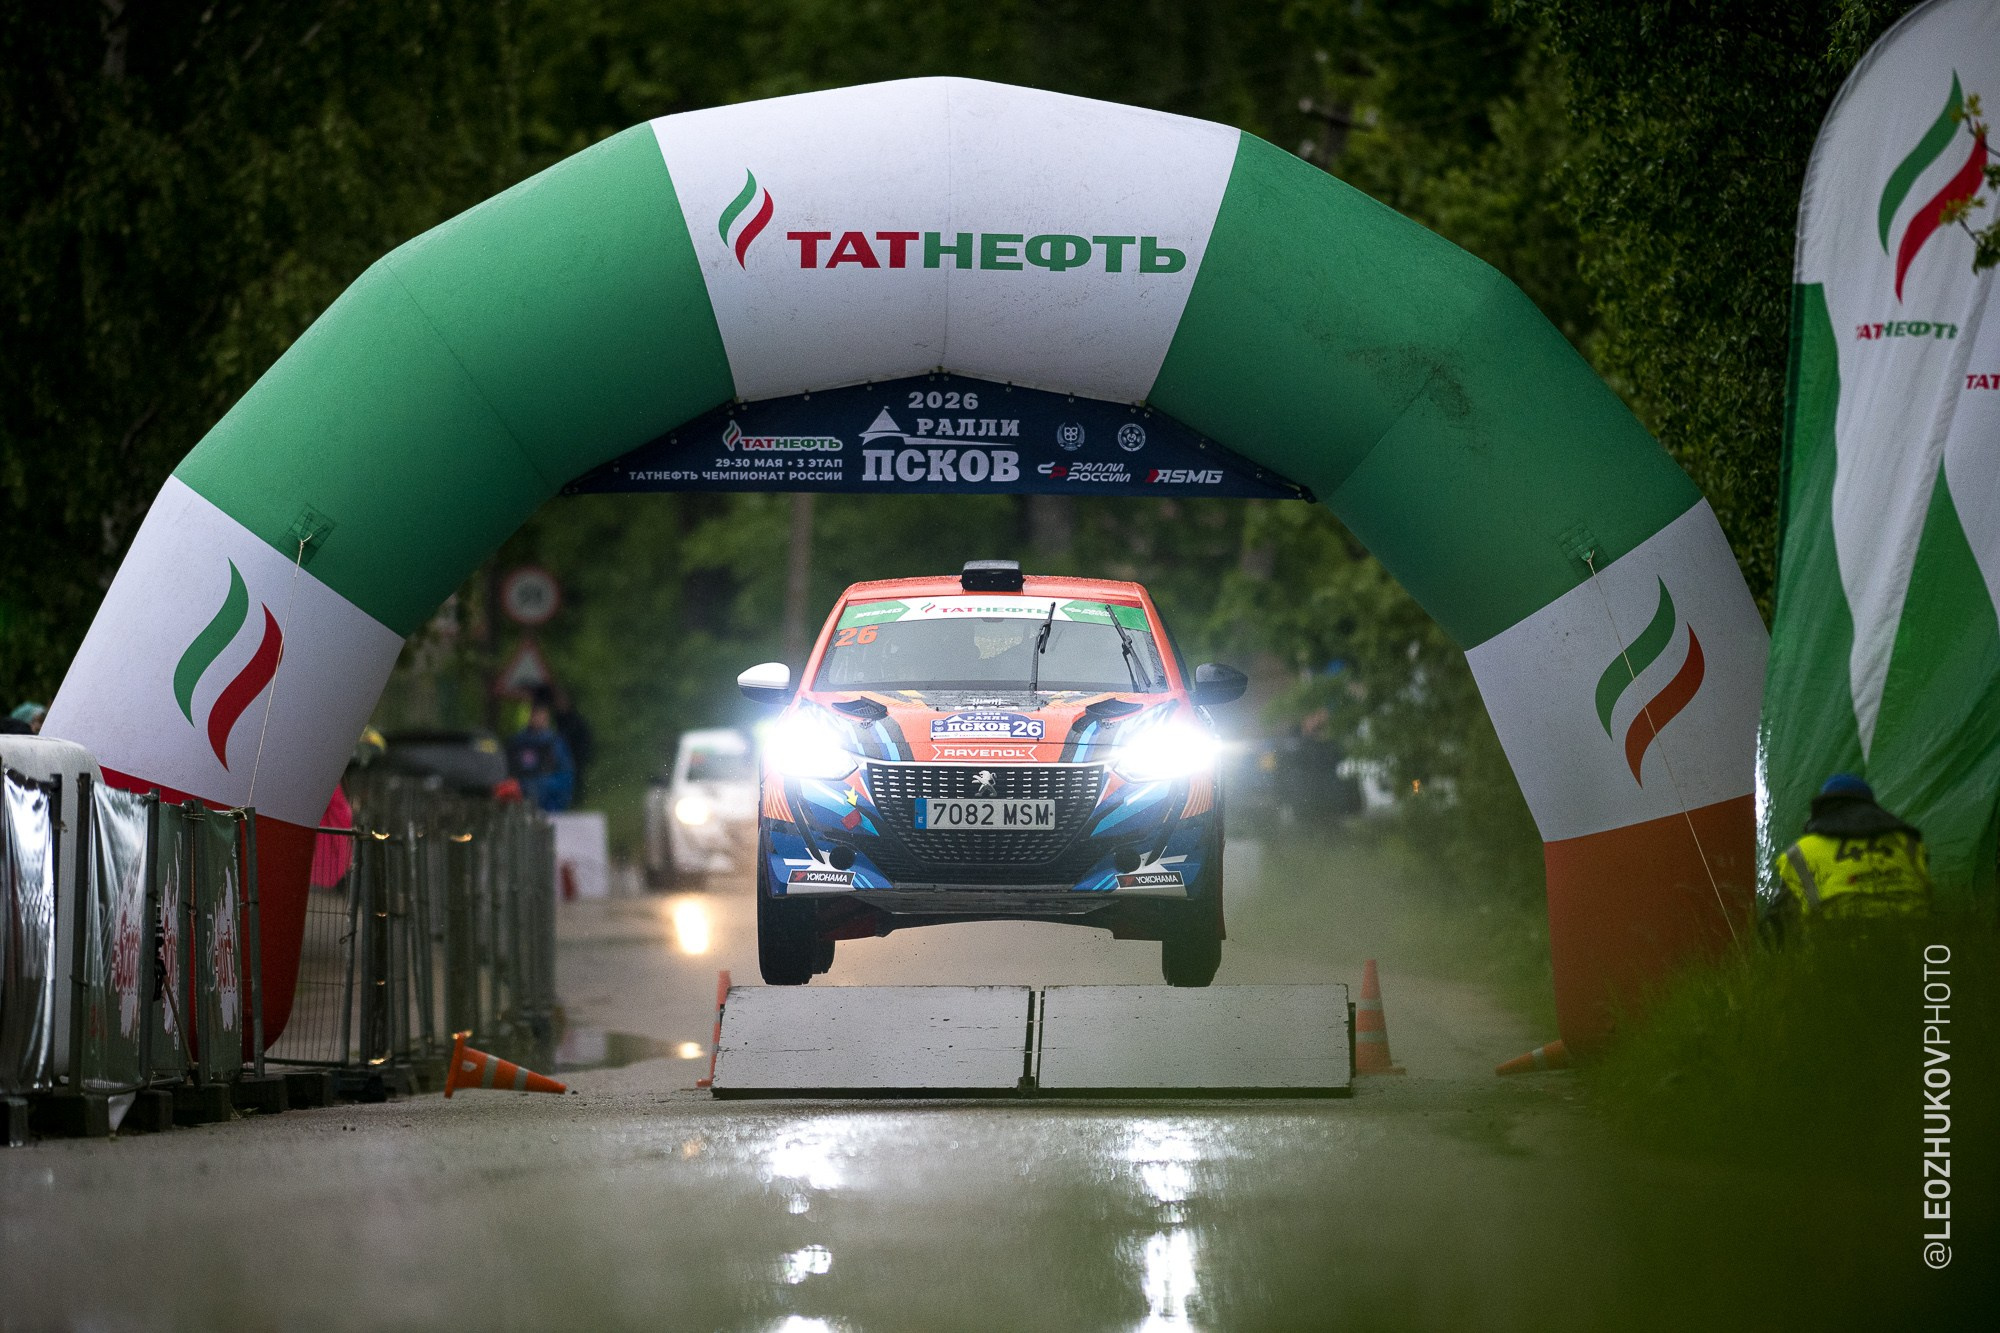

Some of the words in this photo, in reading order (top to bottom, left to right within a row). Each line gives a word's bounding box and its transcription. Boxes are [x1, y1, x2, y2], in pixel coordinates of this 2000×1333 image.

[786, 231, 1187, 274] ТАТНЕФТЬ
[908, 391, 979, 410] 2026
[916, 418, 1020, 437] РАЛЛИ
[740, 437, 843, 451] ТАТНЕФТЬ
[715, 458, 750, 468] 29-30
[754, 458, 783, 468] МАЯ
[796, 458, 805, 468] 3
[808, 458, 843, 468] ЭТАП
[862, 448, 1020, 482] ПСКОВ
[1070, 462, 1125, 473] РАЛЛИ
[629, 471, 699, 481] ТАТНЕФТЬ
[702, 471, 785, 481] ЧЕМПИОНАТ
[789, 471, 843, 481] РОССИИ
[1066, 472, 1131, 483] РОССИИ
[1153, 469, 1224, 484] ASMG
[938, 606, 1050, 615] ТАТНЕФТЬ
[835, 625, 878, 647] 26
[947, 722, 1011, 732] ПСКОВ
[1012, 721, 1042, 737] 26
[943, 748, 1026, 757] RAVENOL
[917, 816, 924, 824] E
[933, 803, 995, 826] 7082
[1003, 803, 1049, 826] MSM
[806, 873, 848, 883] YOKOHAMA
[1135, 874, 1179, 884] YOKOHAMA
